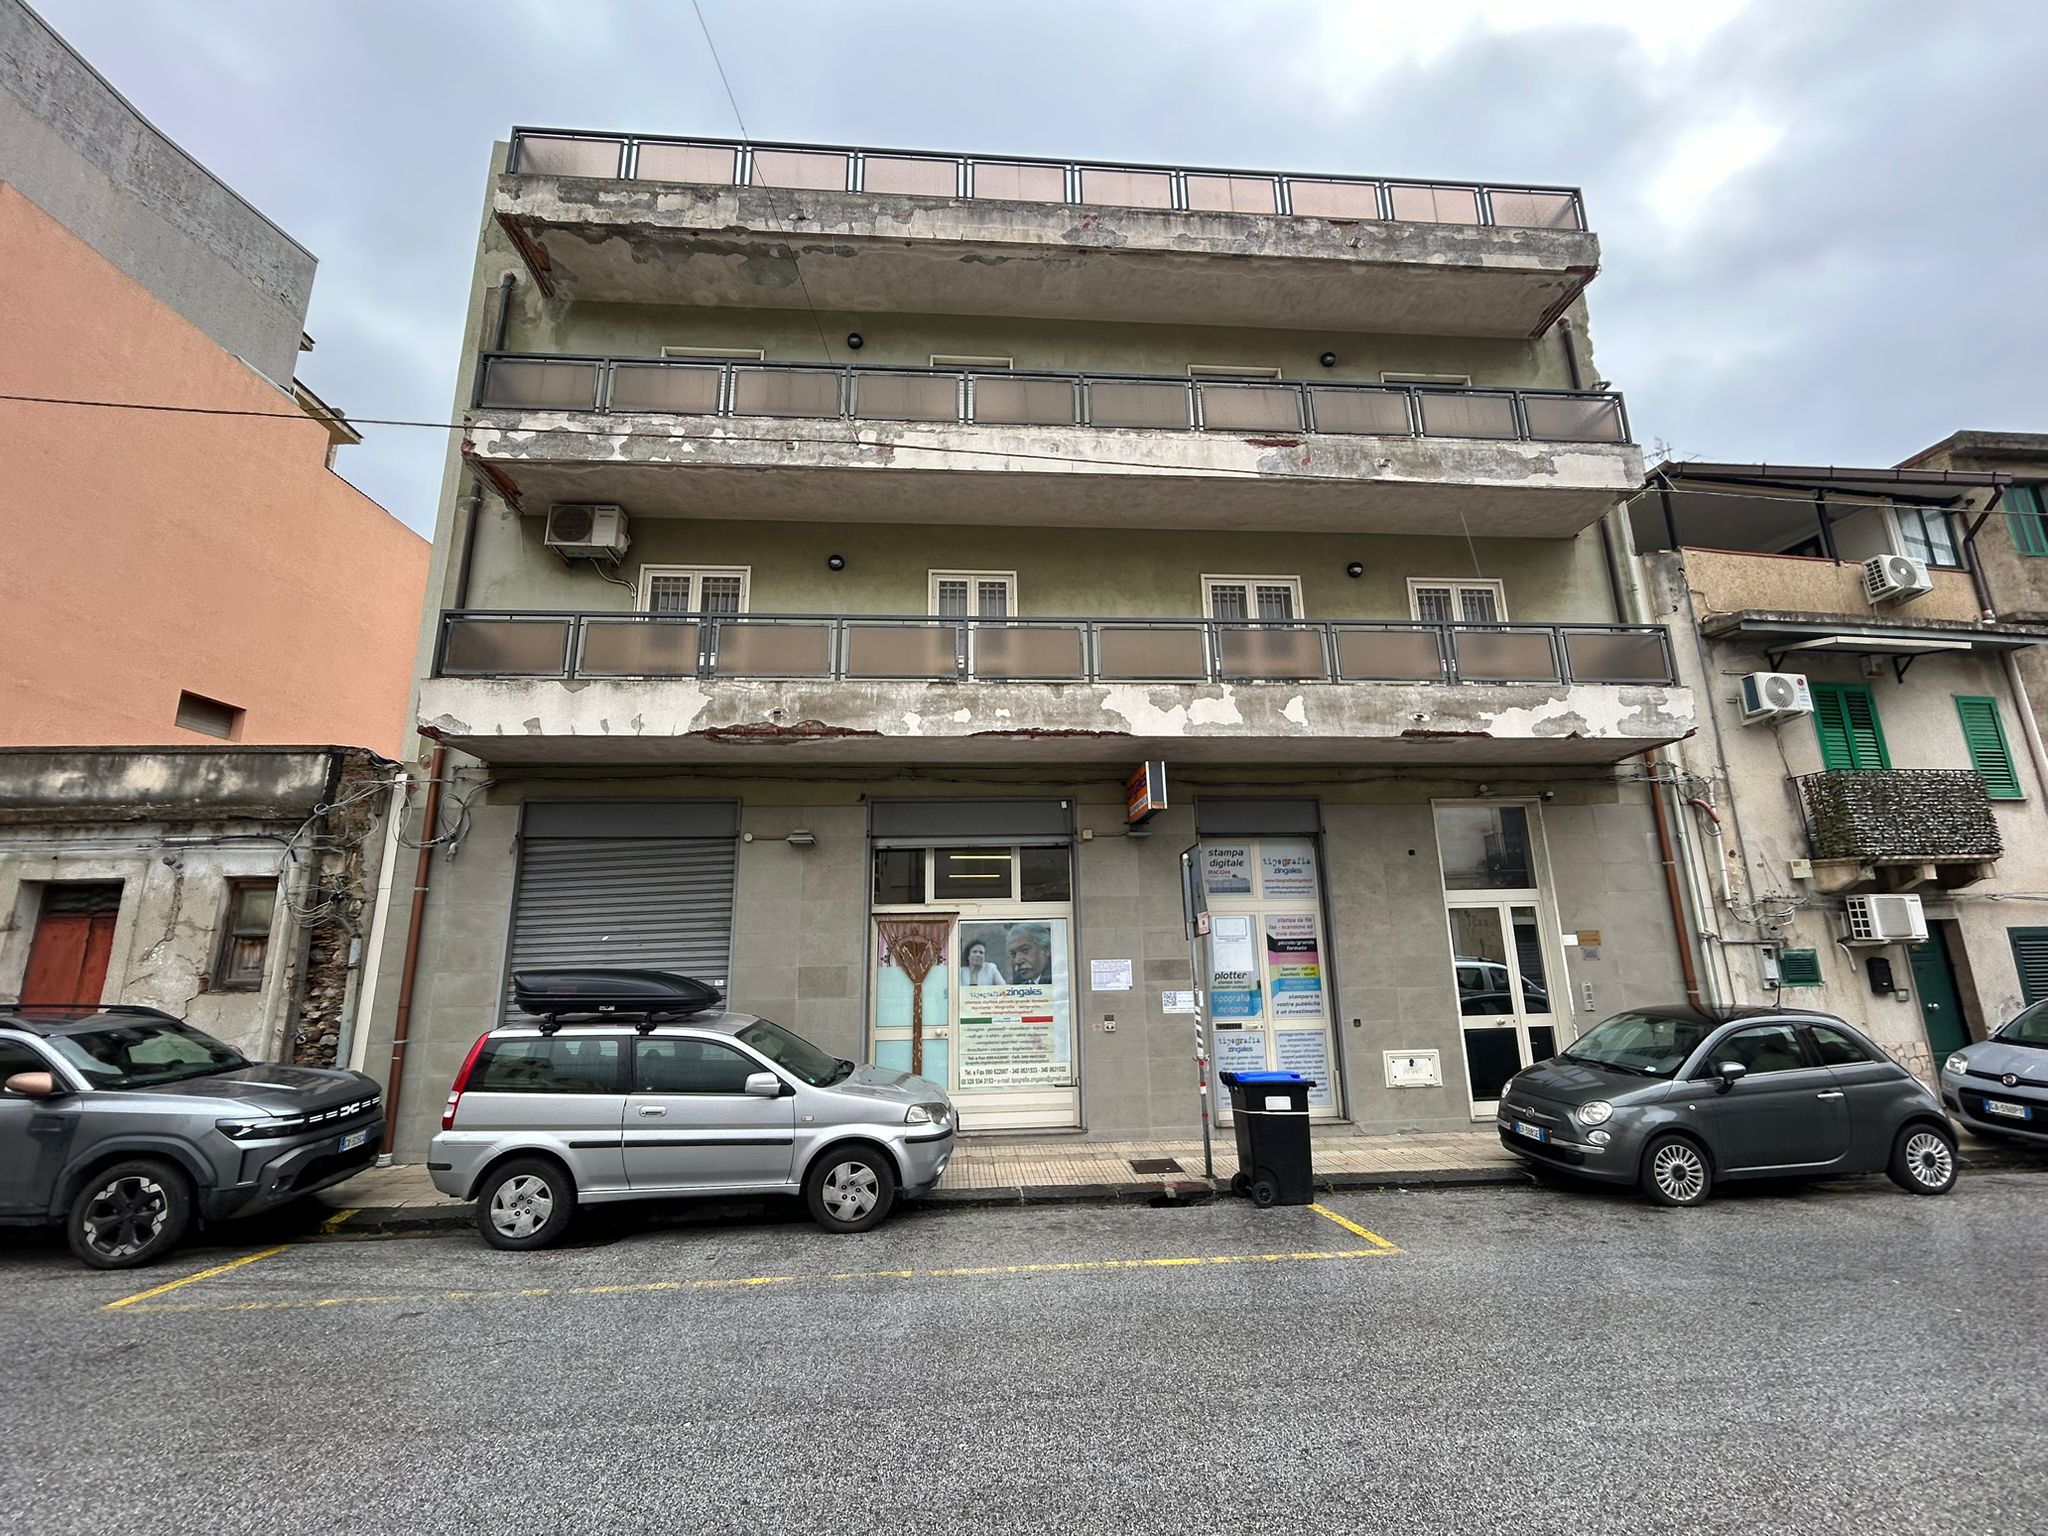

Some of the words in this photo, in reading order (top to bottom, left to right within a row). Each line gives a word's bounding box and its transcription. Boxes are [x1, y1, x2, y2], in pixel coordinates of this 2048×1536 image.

[1208, 848, 1244, 858] stampa
[1209, 858, 1244, 869] digitale
[1263, 856, 1311, 867] tipografia
[1273, 867, 1303, 875] zingales
[1214, 971, 1247, 981] plotter
[1006, 987, 1043, 998] zingales
[1214, 993, 1250, 1003] tipografia
[1218, 1036, 1261, 1047] tipografia
[1228, 1046, 1254, 1054] zingales
